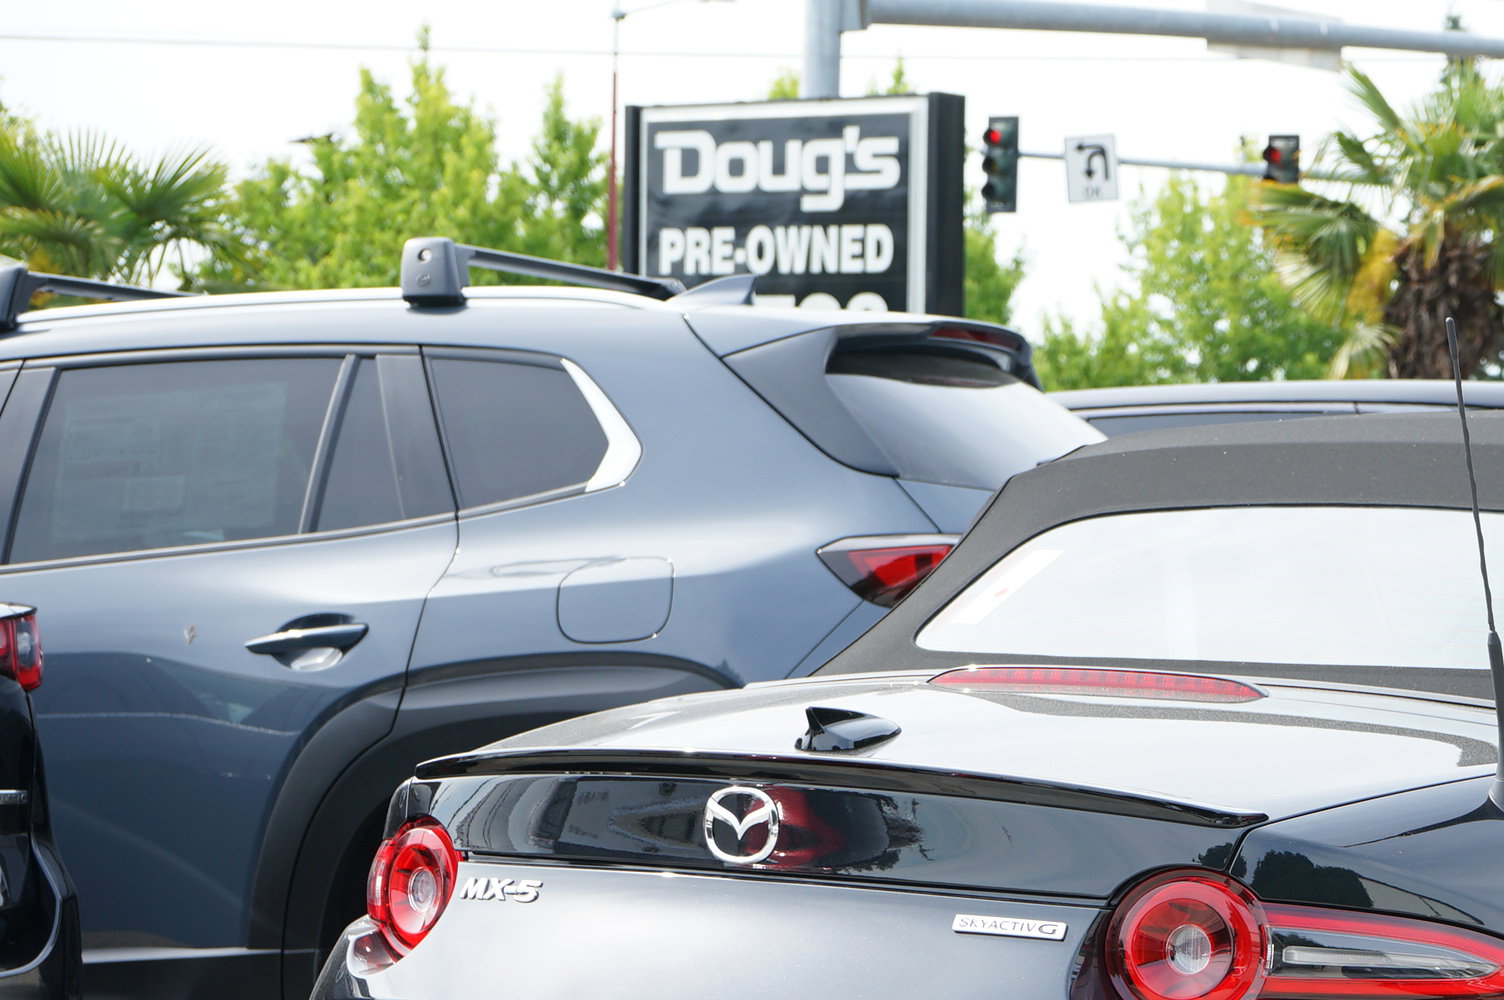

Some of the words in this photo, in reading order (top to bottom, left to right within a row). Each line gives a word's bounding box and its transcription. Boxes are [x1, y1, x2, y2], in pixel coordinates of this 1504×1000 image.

[653, 123, 901, 213] Doug's
[657, 223, 896, 275] PRE-OWNED
[459, 876, 543, 903] MX-5
